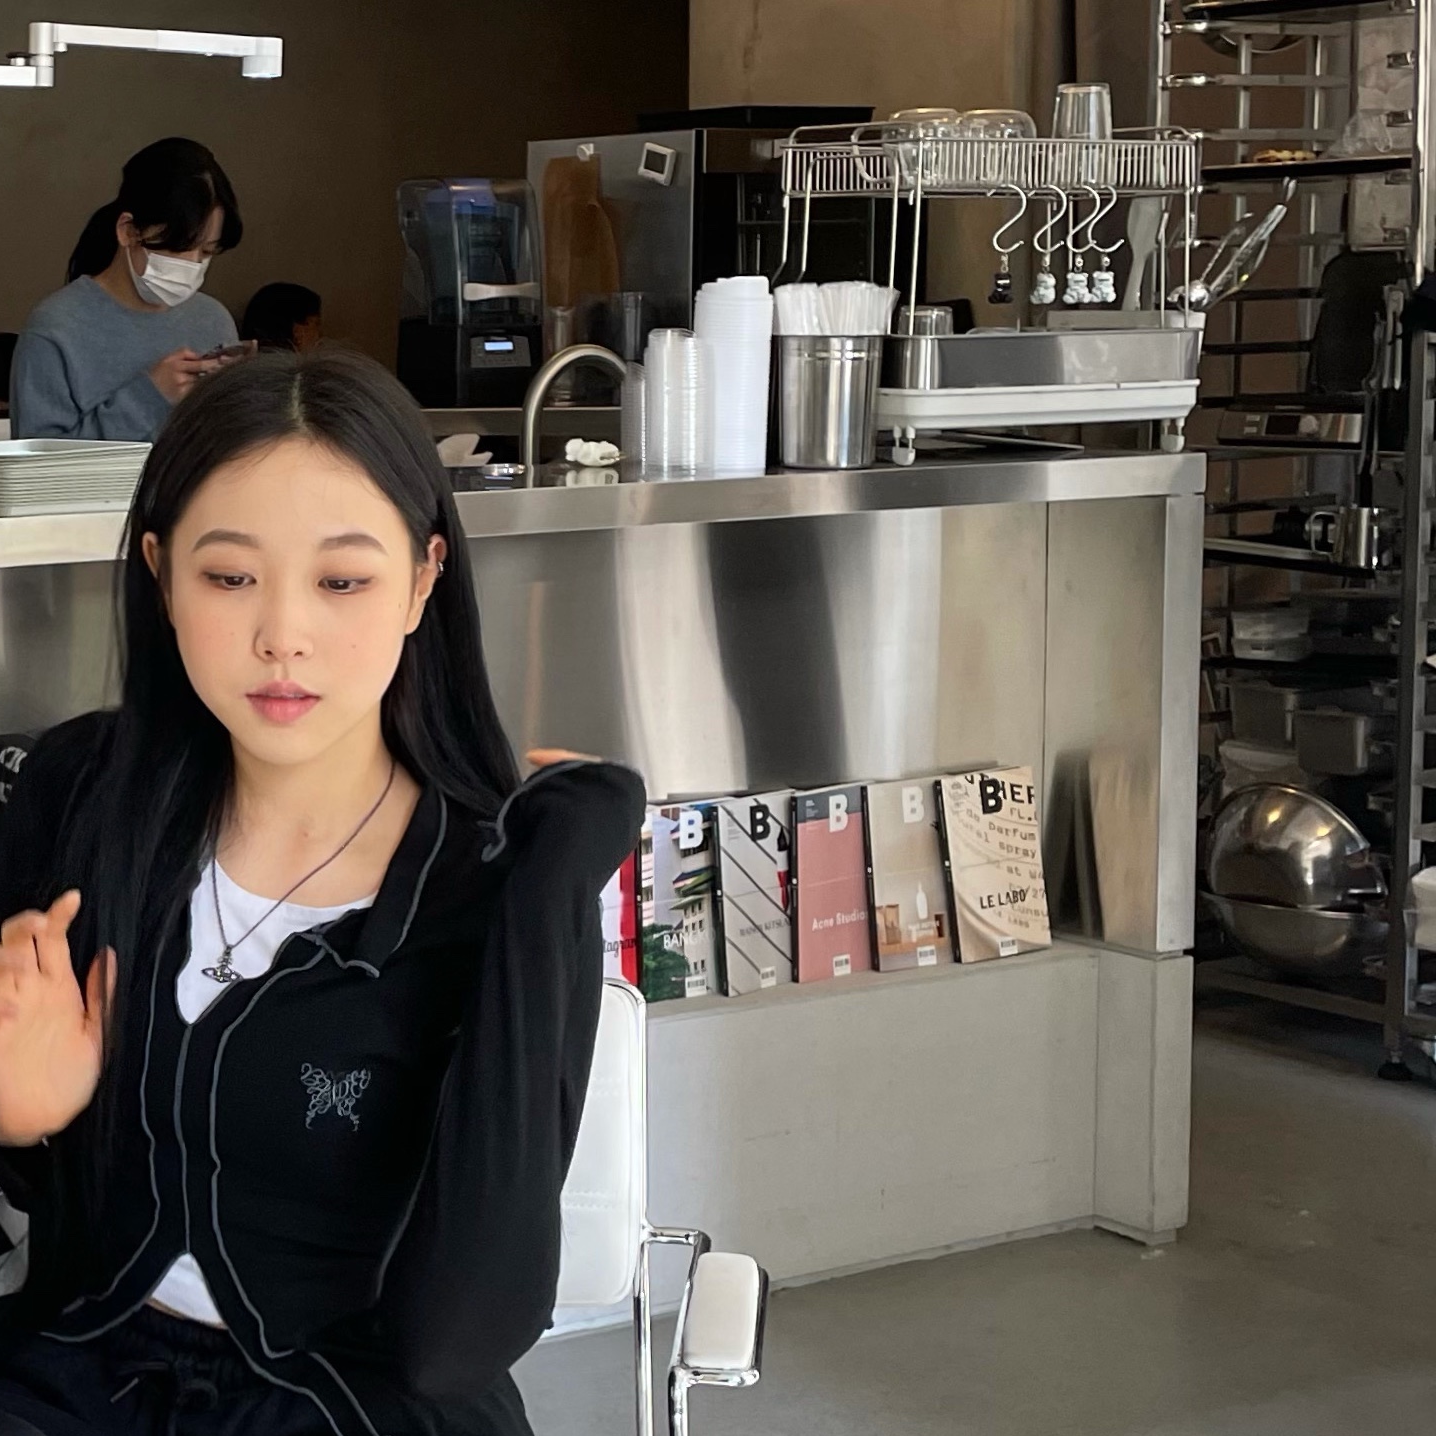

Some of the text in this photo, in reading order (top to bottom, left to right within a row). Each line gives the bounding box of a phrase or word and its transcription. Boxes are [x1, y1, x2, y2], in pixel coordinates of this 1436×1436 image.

[828, 794, 848, 833] B
[902, 786, 925, 824] B
[979, 778, 1003, 815] B
[679, 810, 703, 850] B
[749, 803, 771, 842] B
[979, 888, 1026, 909] LE LABO
[811, 915, 834, 931] Acne
